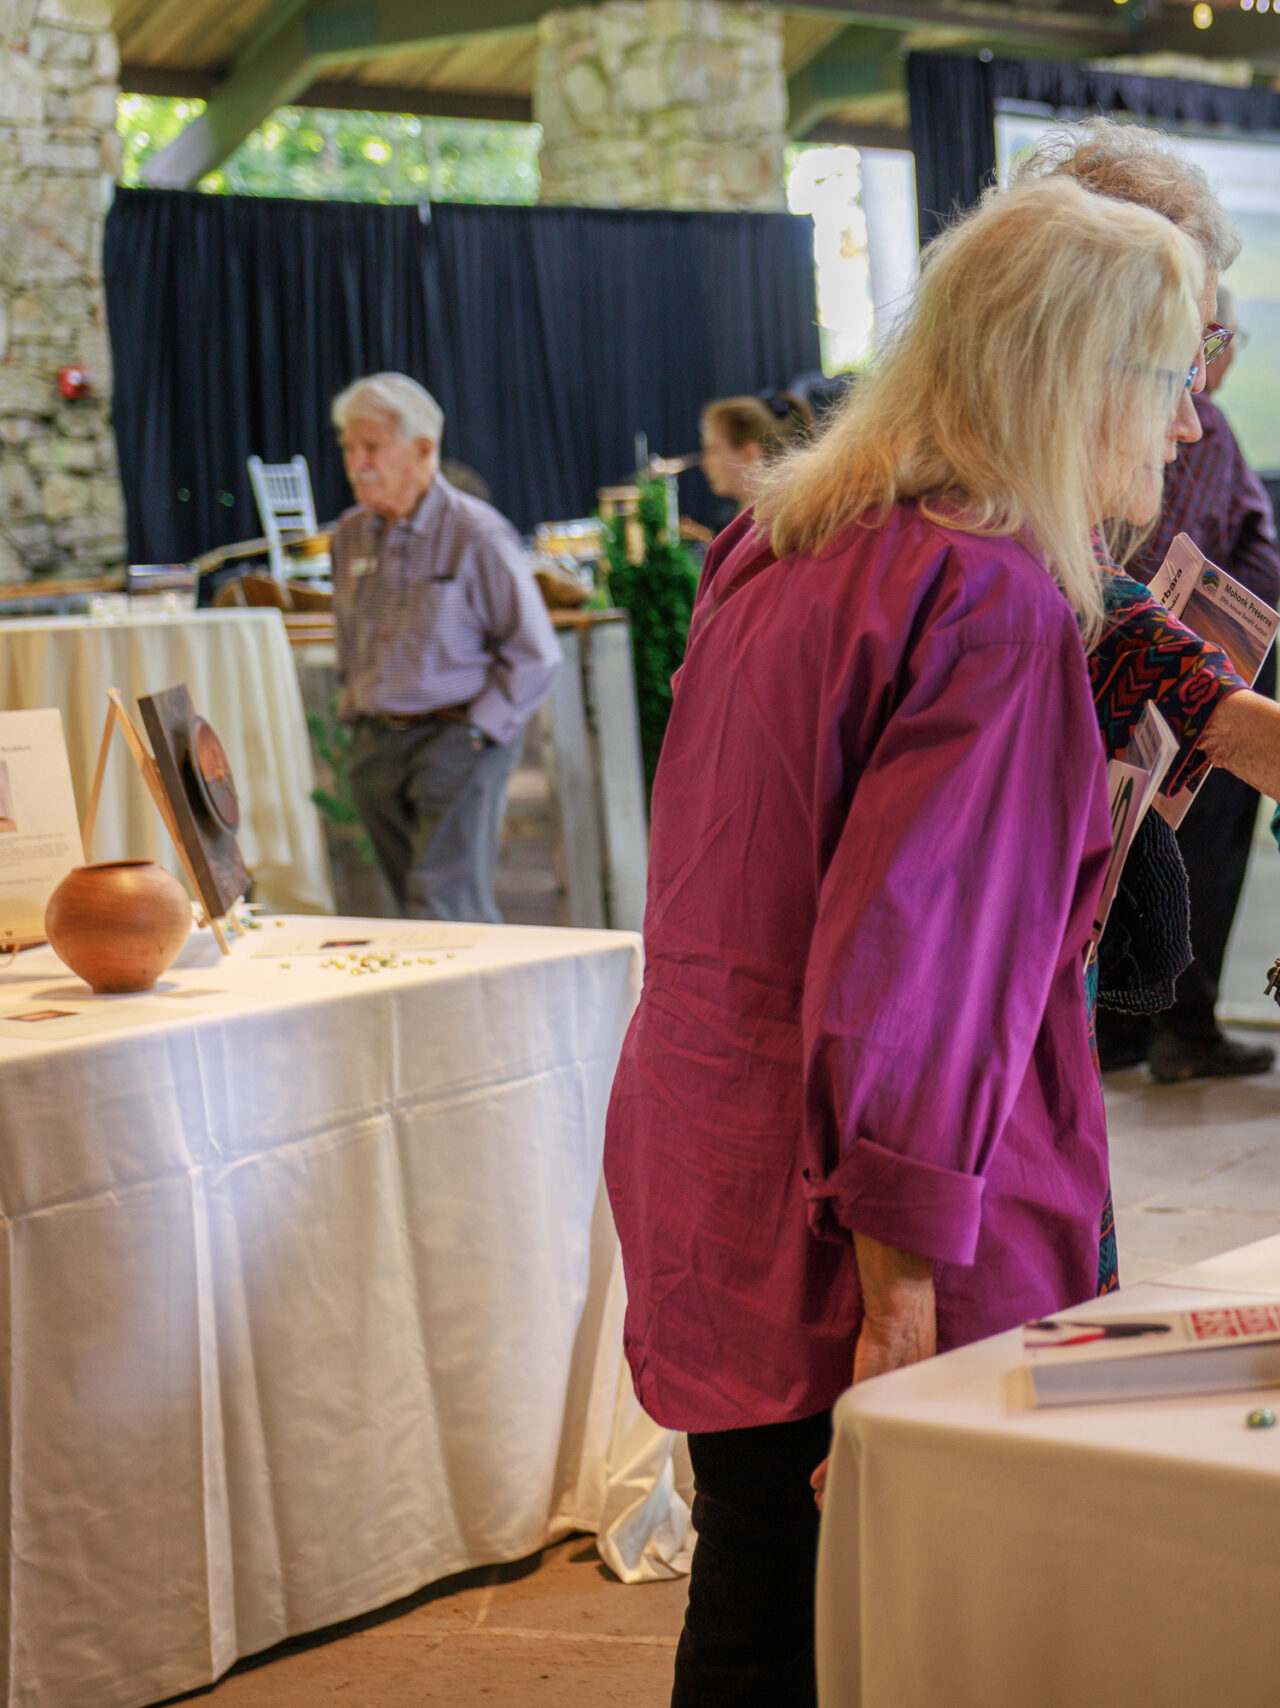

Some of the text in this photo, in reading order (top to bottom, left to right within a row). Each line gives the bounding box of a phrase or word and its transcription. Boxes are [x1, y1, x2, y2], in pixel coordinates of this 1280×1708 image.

[1160, 568, 1183, 606] rbara
[1224, 583, 1273, 629] Mohonk Preserve
